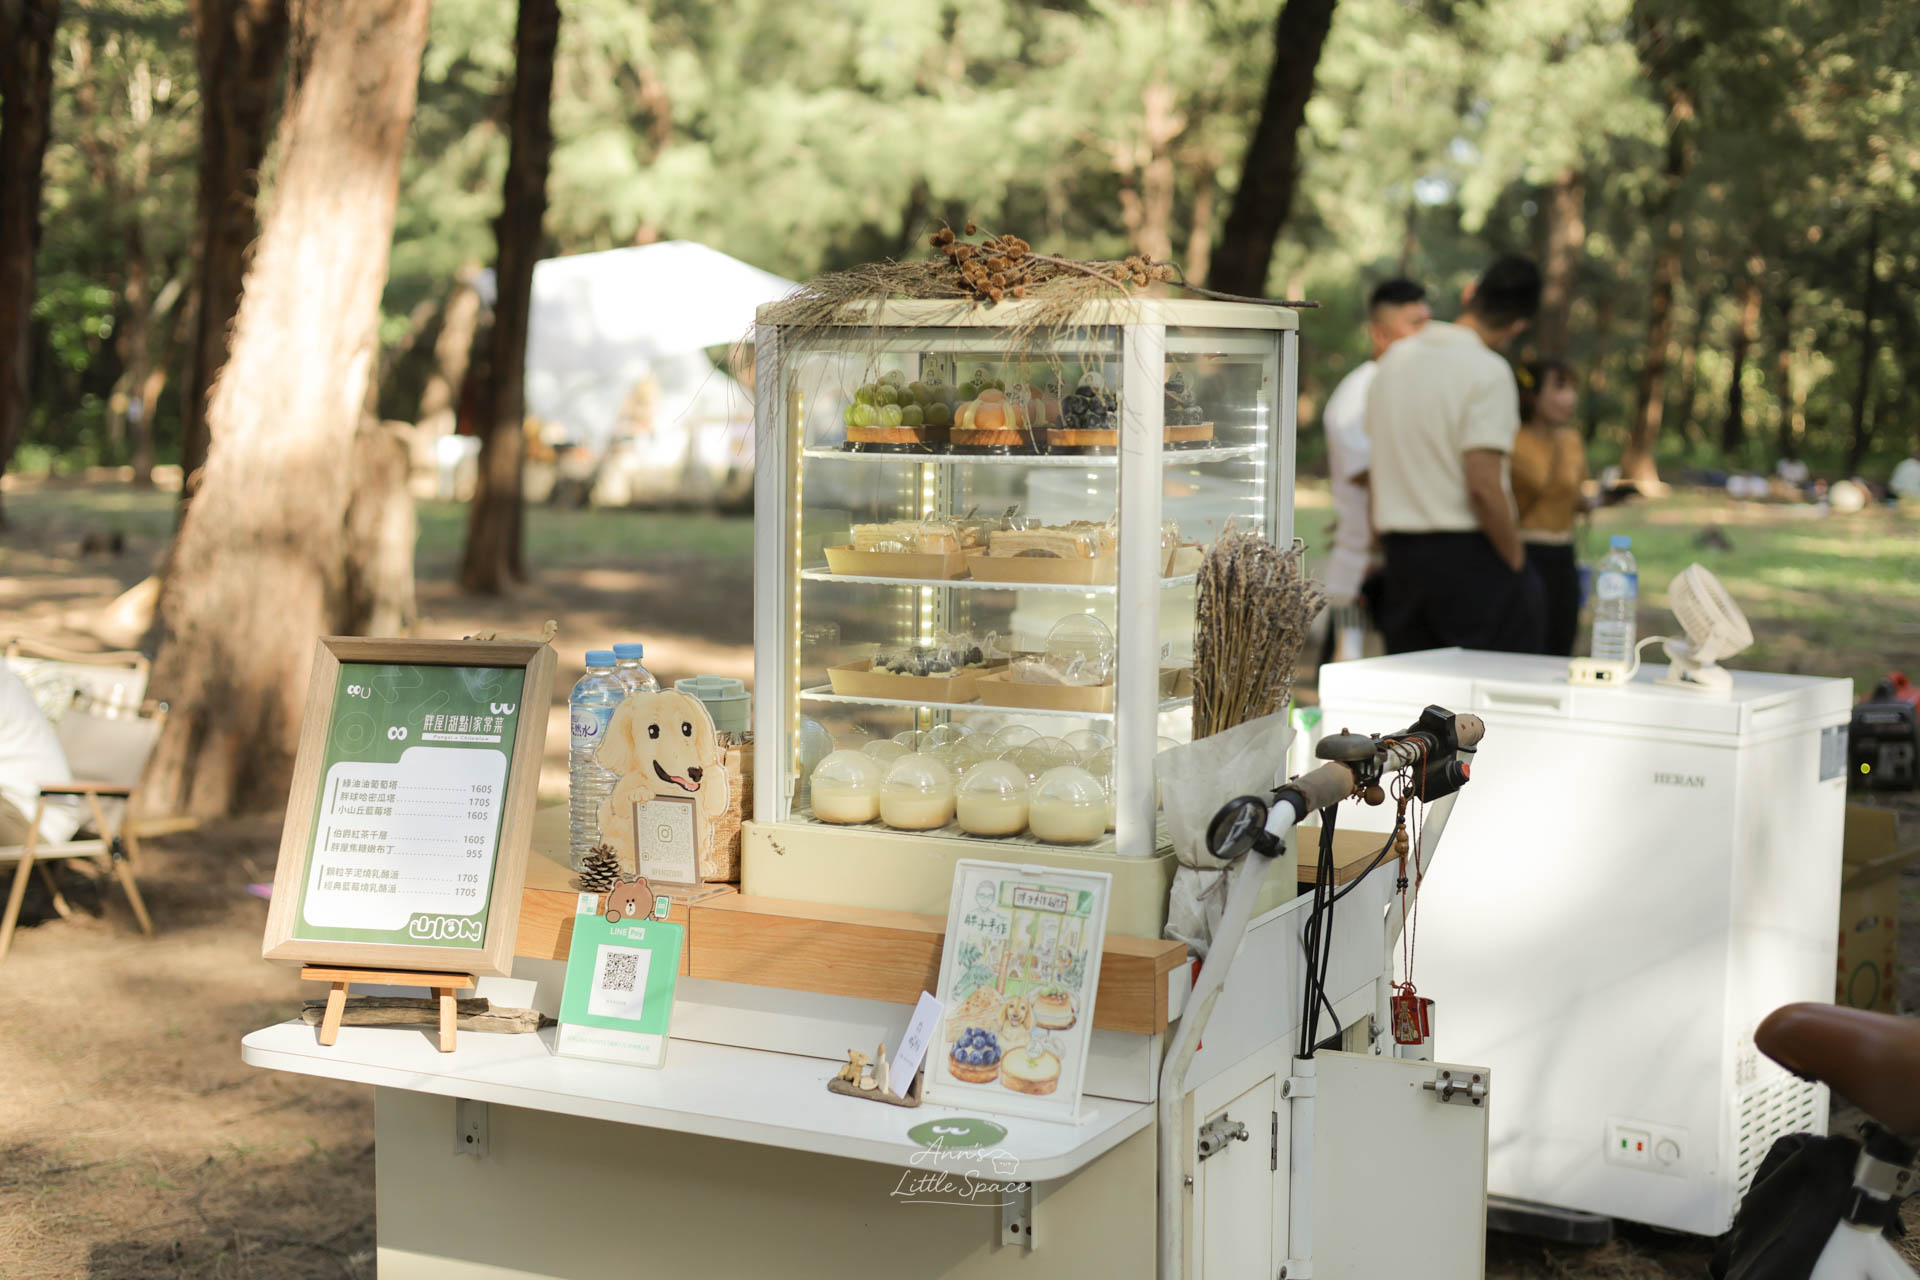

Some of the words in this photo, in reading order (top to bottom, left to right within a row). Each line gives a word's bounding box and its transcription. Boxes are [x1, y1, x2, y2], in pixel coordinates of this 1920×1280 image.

[471, 785, 492, 794] 160$
[469, 798, 490, 807] 170$
[467, 811, 488, 820] 160$
[463, 835, 485, 844] 160$
[466, 849, 483, 859] 95$
[457, 874, 479, 883] 170$
[455, 888, 477, 897] 170$
[610, 927, 627, 936] LINE
